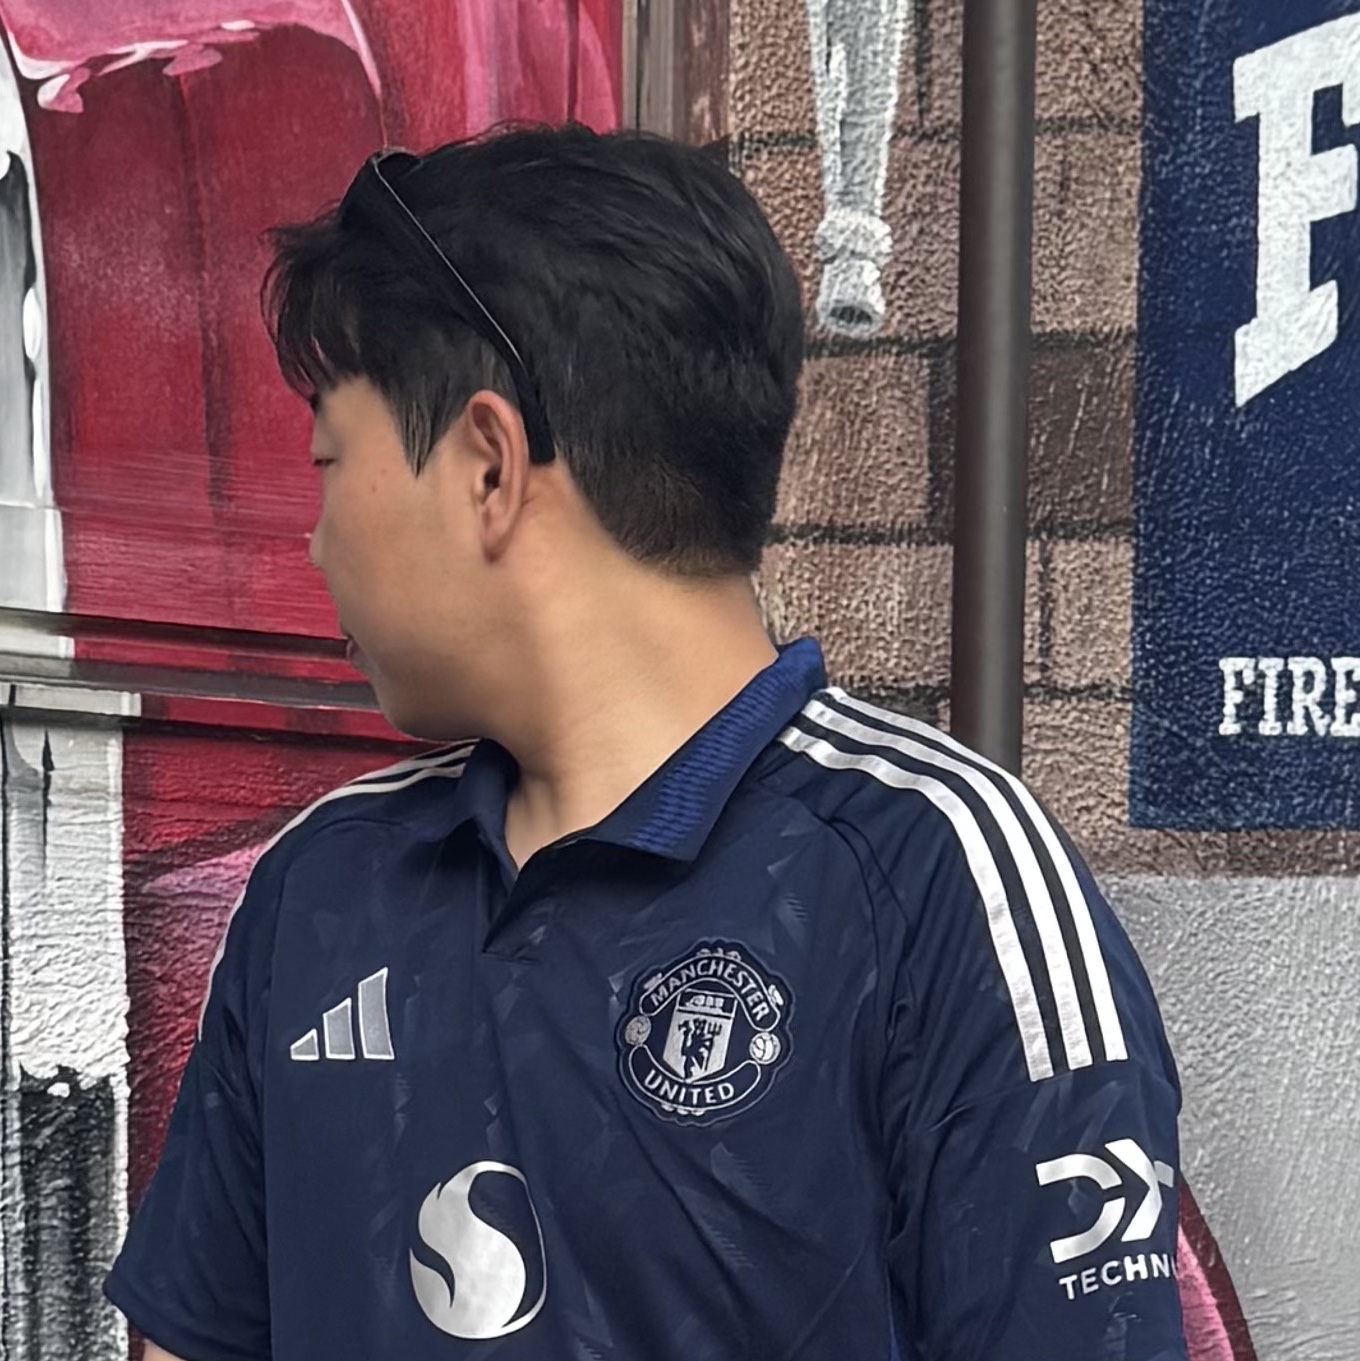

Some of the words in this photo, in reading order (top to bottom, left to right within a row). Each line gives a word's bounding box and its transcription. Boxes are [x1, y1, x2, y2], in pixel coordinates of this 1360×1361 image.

[649, 958, 771, 1022] MANCHESTER
[643, 1068, 735, 1105] UNITED
[1058, 1253, 1178, 1301] TECHN
